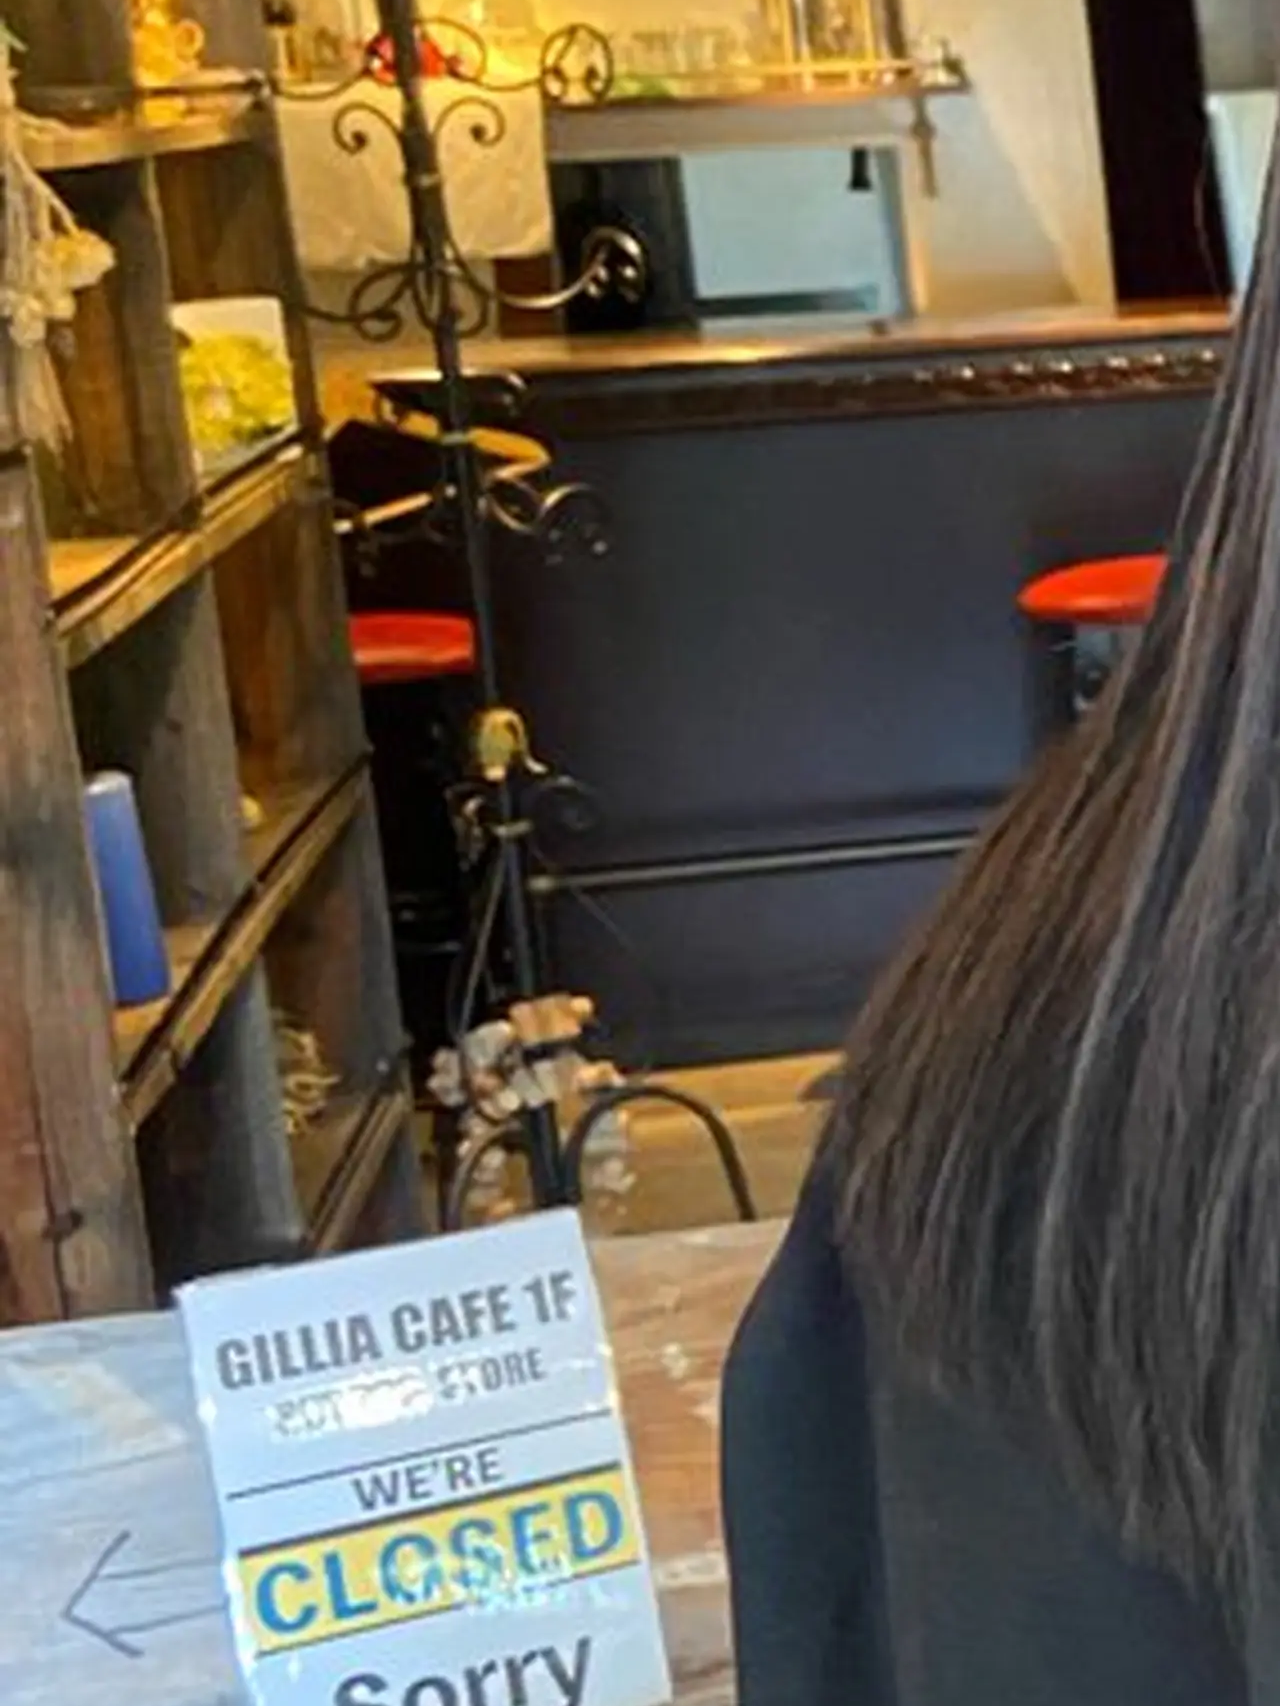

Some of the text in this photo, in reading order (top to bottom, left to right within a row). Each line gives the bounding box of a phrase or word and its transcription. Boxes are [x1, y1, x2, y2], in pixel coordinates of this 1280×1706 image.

[216, 1269, 577, 1390] GILLIA CAFE 1F
[437, 1347, 547, 1399] STORE
[352, 1447, 506, 1511] WE'RE
[255, 1492, 624, 1634] CLOSED
